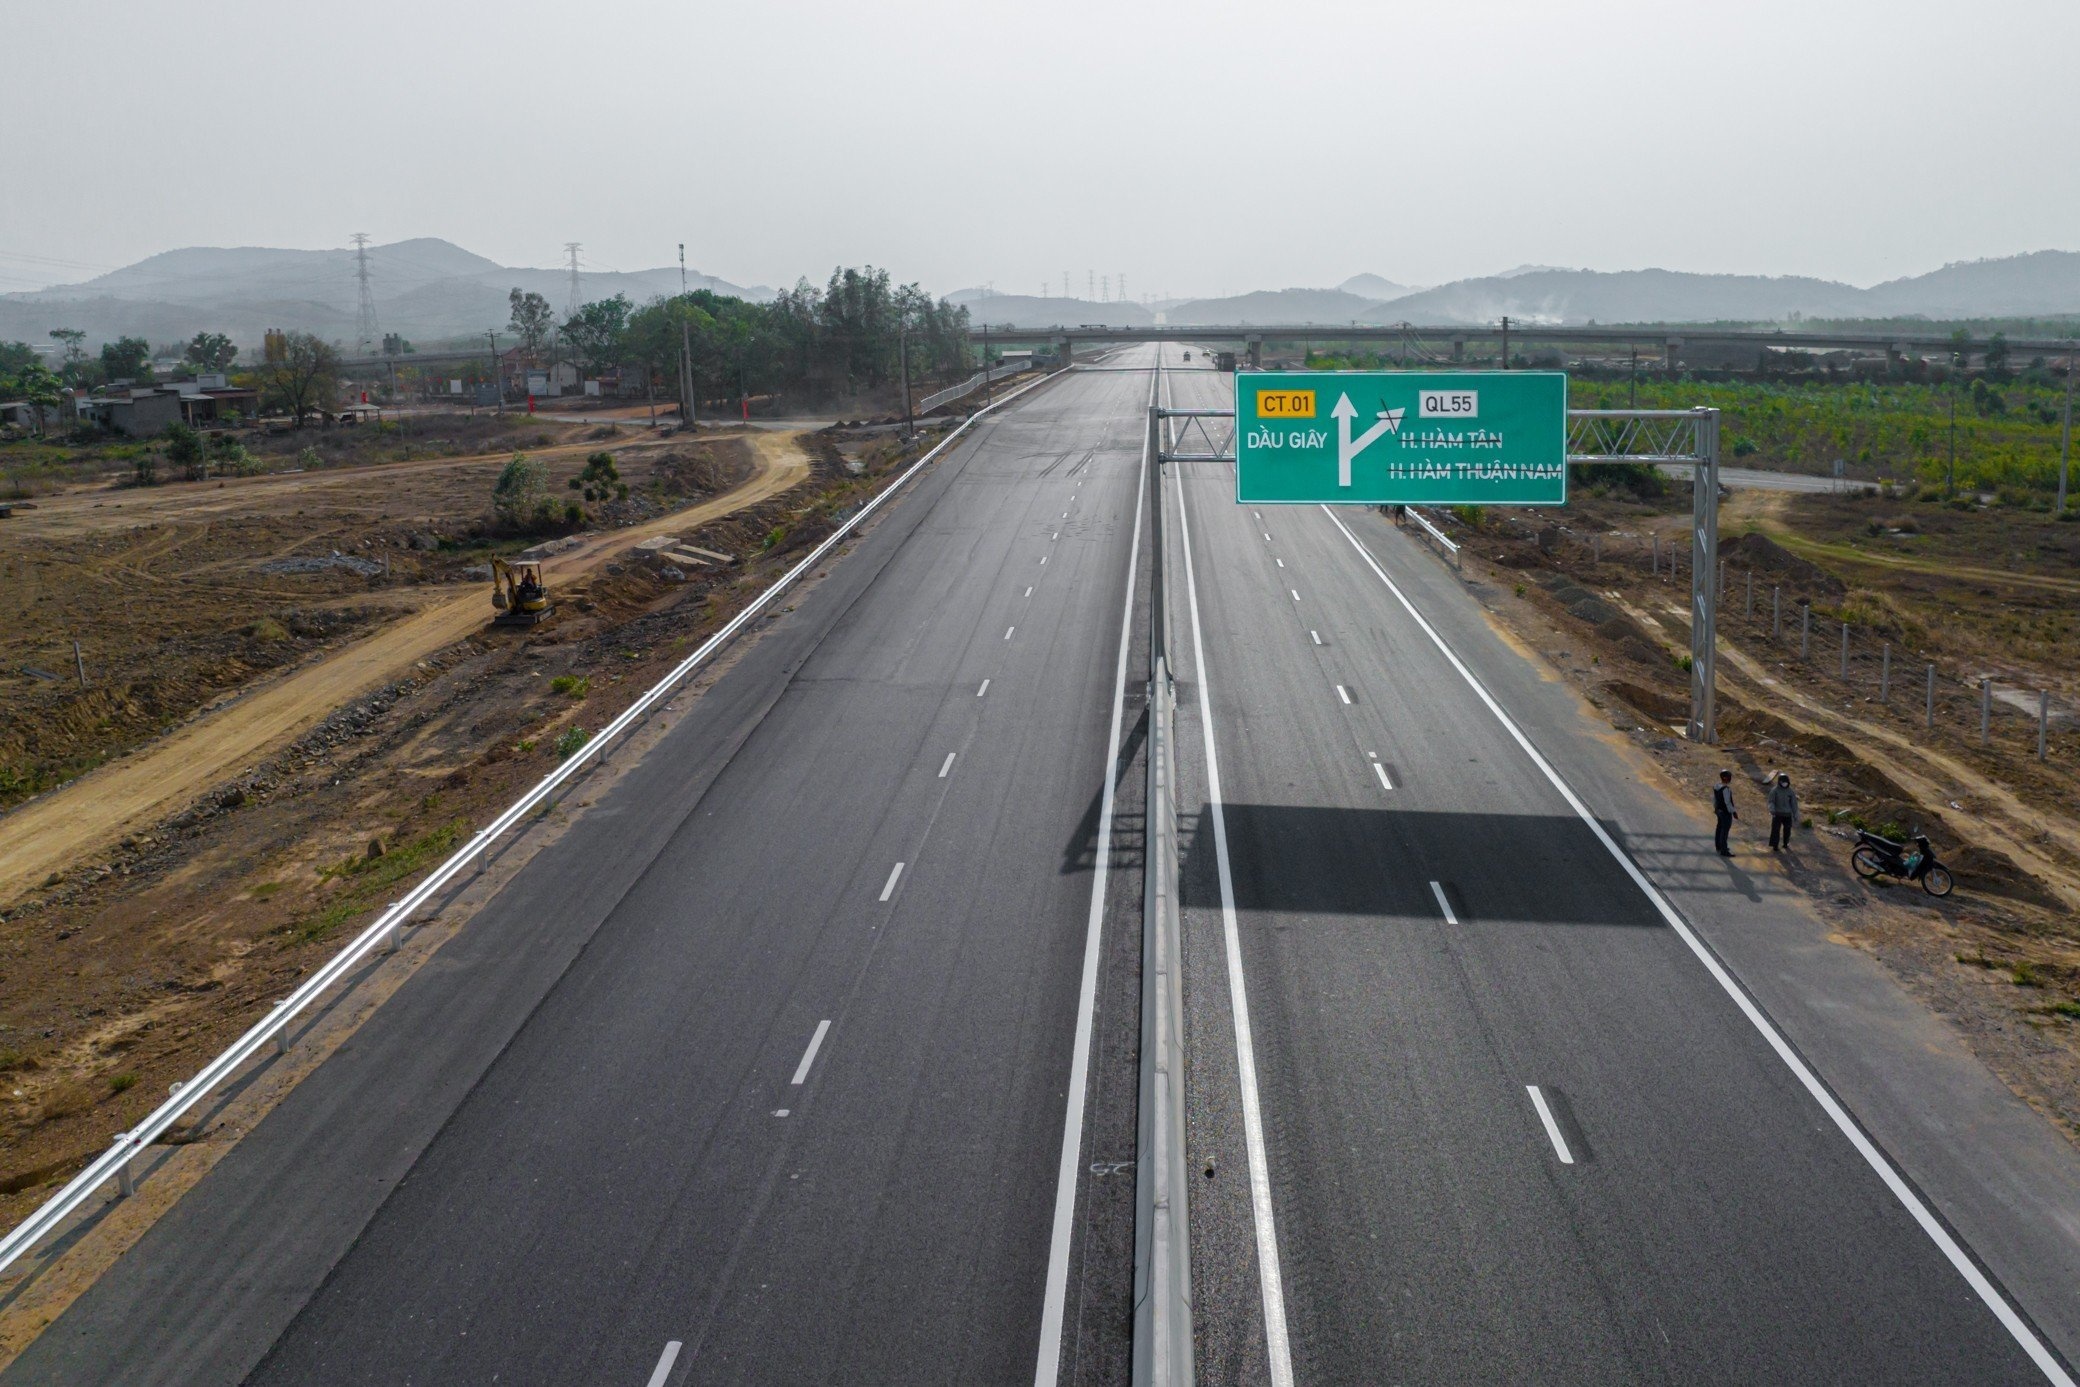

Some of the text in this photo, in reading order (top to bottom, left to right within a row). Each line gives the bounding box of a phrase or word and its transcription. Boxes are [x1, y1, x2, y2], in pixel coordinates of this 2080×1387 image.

[1264, 395, 1309, 412] CT.01
[1425, 395, 1472, 413] QL55
[1247, 424, 1328, 449] DẦU GIÂY
[1401, 427, 1503, 449] H. HÀM TÂN
[1390, 458, 1562, 483] H. HÀM THUẬN NAM
